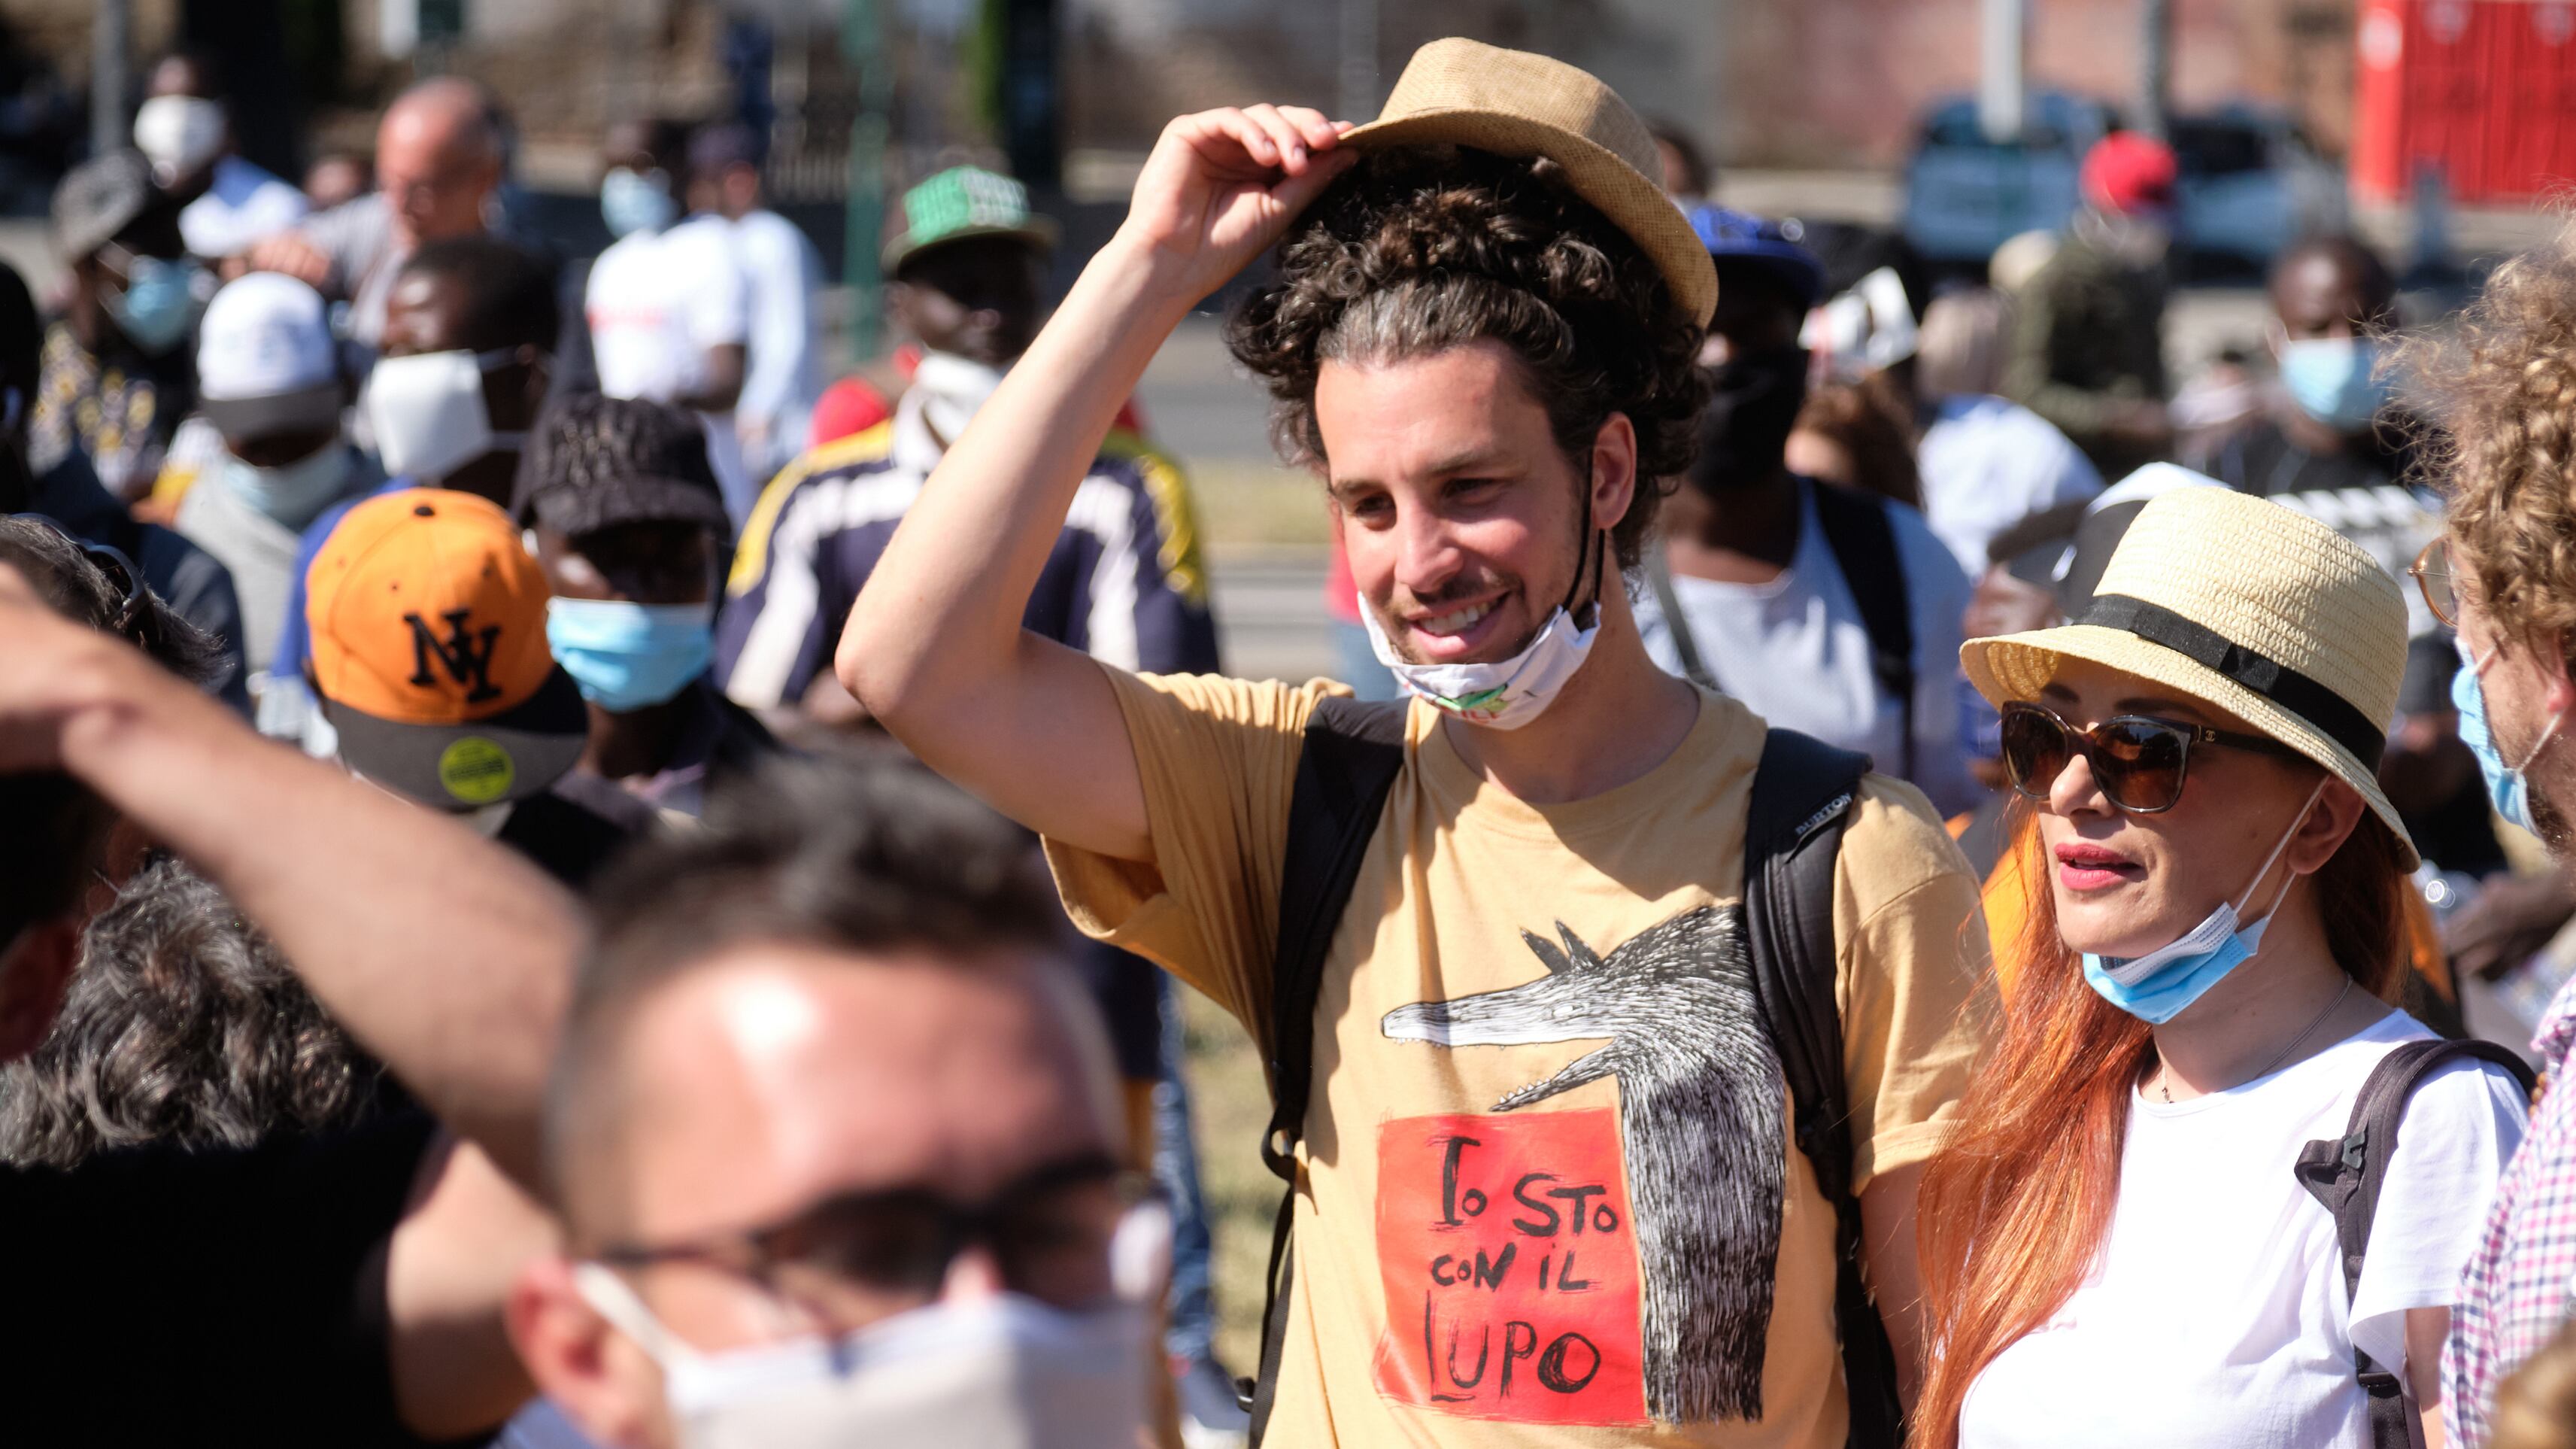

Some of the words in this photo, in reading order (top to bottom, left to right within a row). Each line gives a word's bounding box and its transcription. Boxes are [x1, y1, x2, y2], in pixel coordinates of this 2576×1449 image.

[403, 608, 502, 703] NY
[1795, 793, 1852, 834] BURTON
[1424, 1289, 1601, 1402] LUPO
